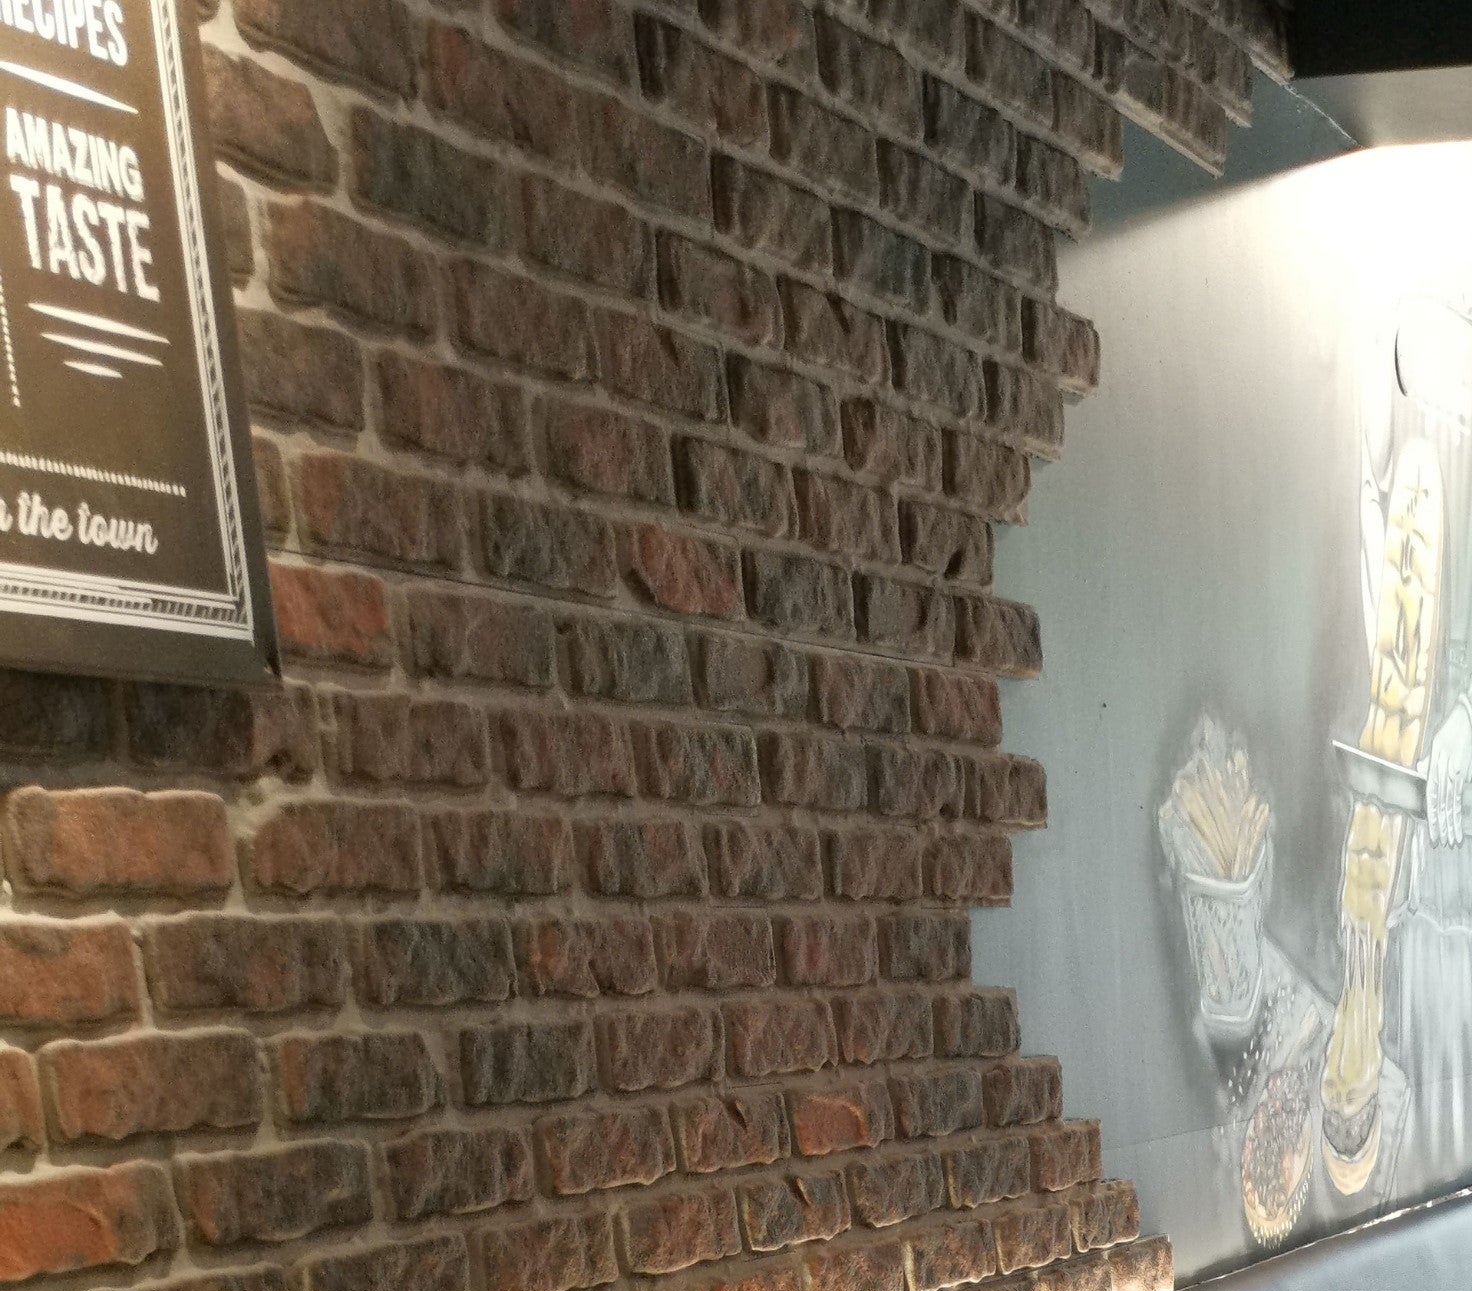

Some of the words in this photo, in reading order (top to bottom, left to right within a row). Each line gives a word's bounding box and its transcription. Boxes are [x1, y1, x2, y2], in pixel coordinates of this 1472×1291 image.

[0, 0, 129, 67] ECIPES
[5, 107, 144, 204] AMAZING
[10, 173, 161, 303] TASTE
[17, 491, 74, 541] the
[77, 501, 159, 555] town
